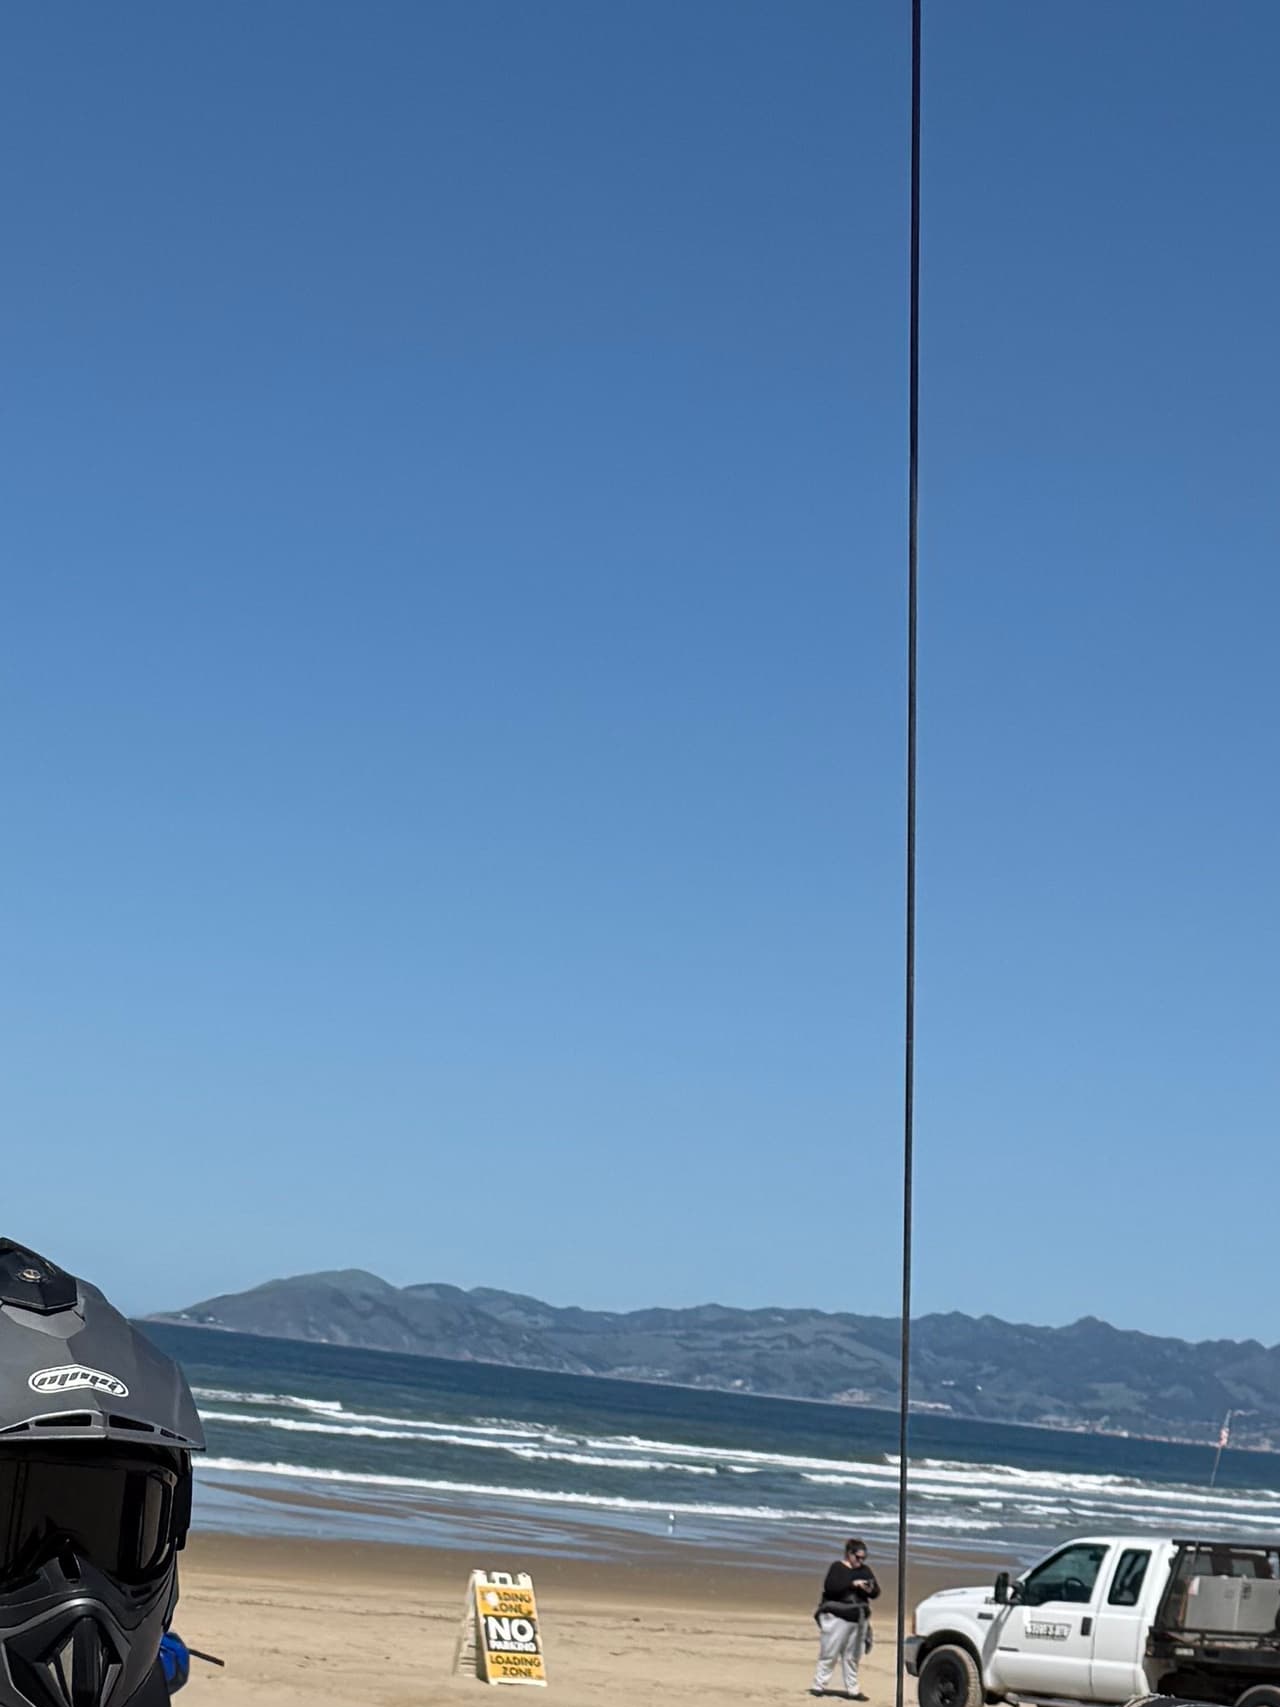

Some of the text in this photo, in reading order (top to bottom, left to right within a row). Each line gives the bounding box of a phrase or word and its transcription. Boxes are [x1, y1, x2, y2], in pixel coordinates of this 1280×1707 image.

[487, 1616, 534, 1643] NO
[490, 1654, 542, 1668] LOADING
[502, 1666, 533, 1678] ZONE
